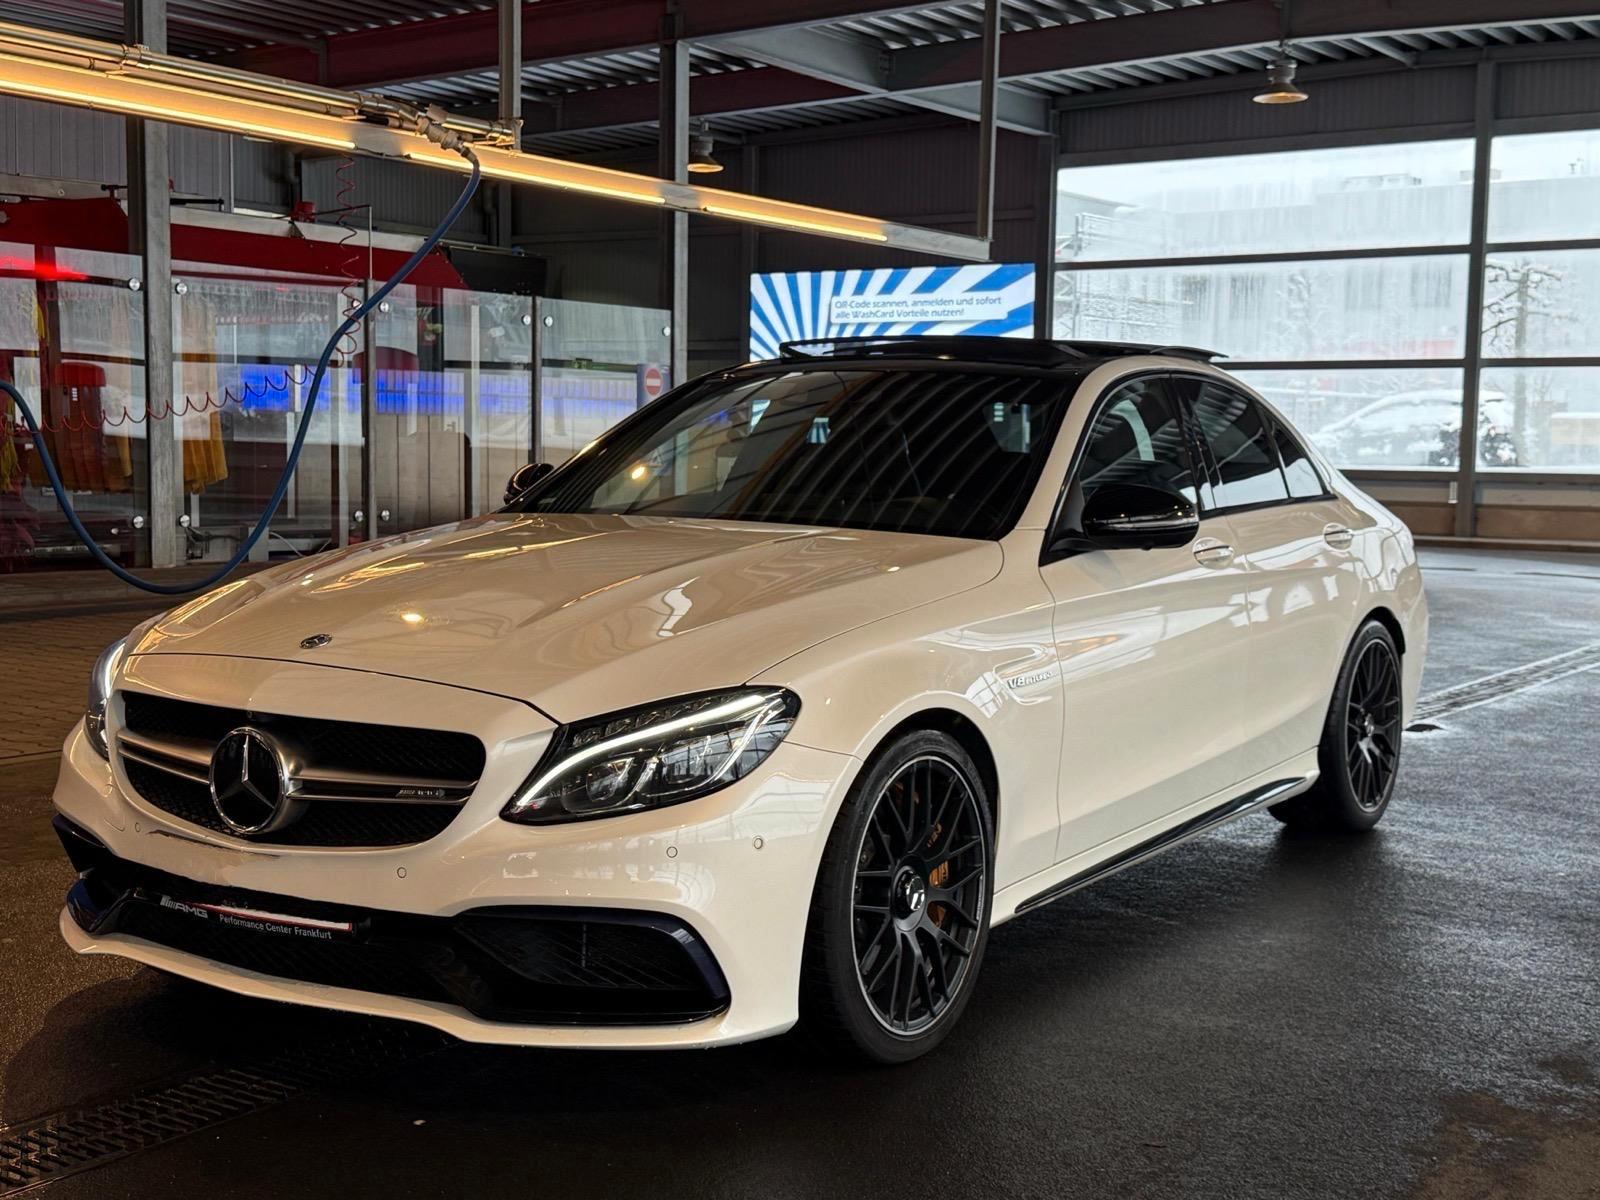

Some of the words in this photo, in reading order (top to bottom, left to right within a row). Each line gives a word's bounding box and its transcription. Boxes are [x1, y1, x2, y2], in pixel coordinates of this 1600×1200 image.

[835, 300, 871, 309] QR-Code
[872, 299, 909, 309] scannen,
[911, 297, 954, 307] anmelden
[955, 297, 974, 306] und
[975, 296, 1002, 305] sofort
[835, 310, 850, 319] alle
[851, 309, 895, 319] WashCard
[896, 309, 929, 318] Vorteile
[931, 308, 965, 317] nutzen!
[1007, 676, 1025, 689] V8
[219, 913, 265, 931] Performance
[265, 922, 293, 935] Center
[294, 926, 333, 940] Frankfurt
